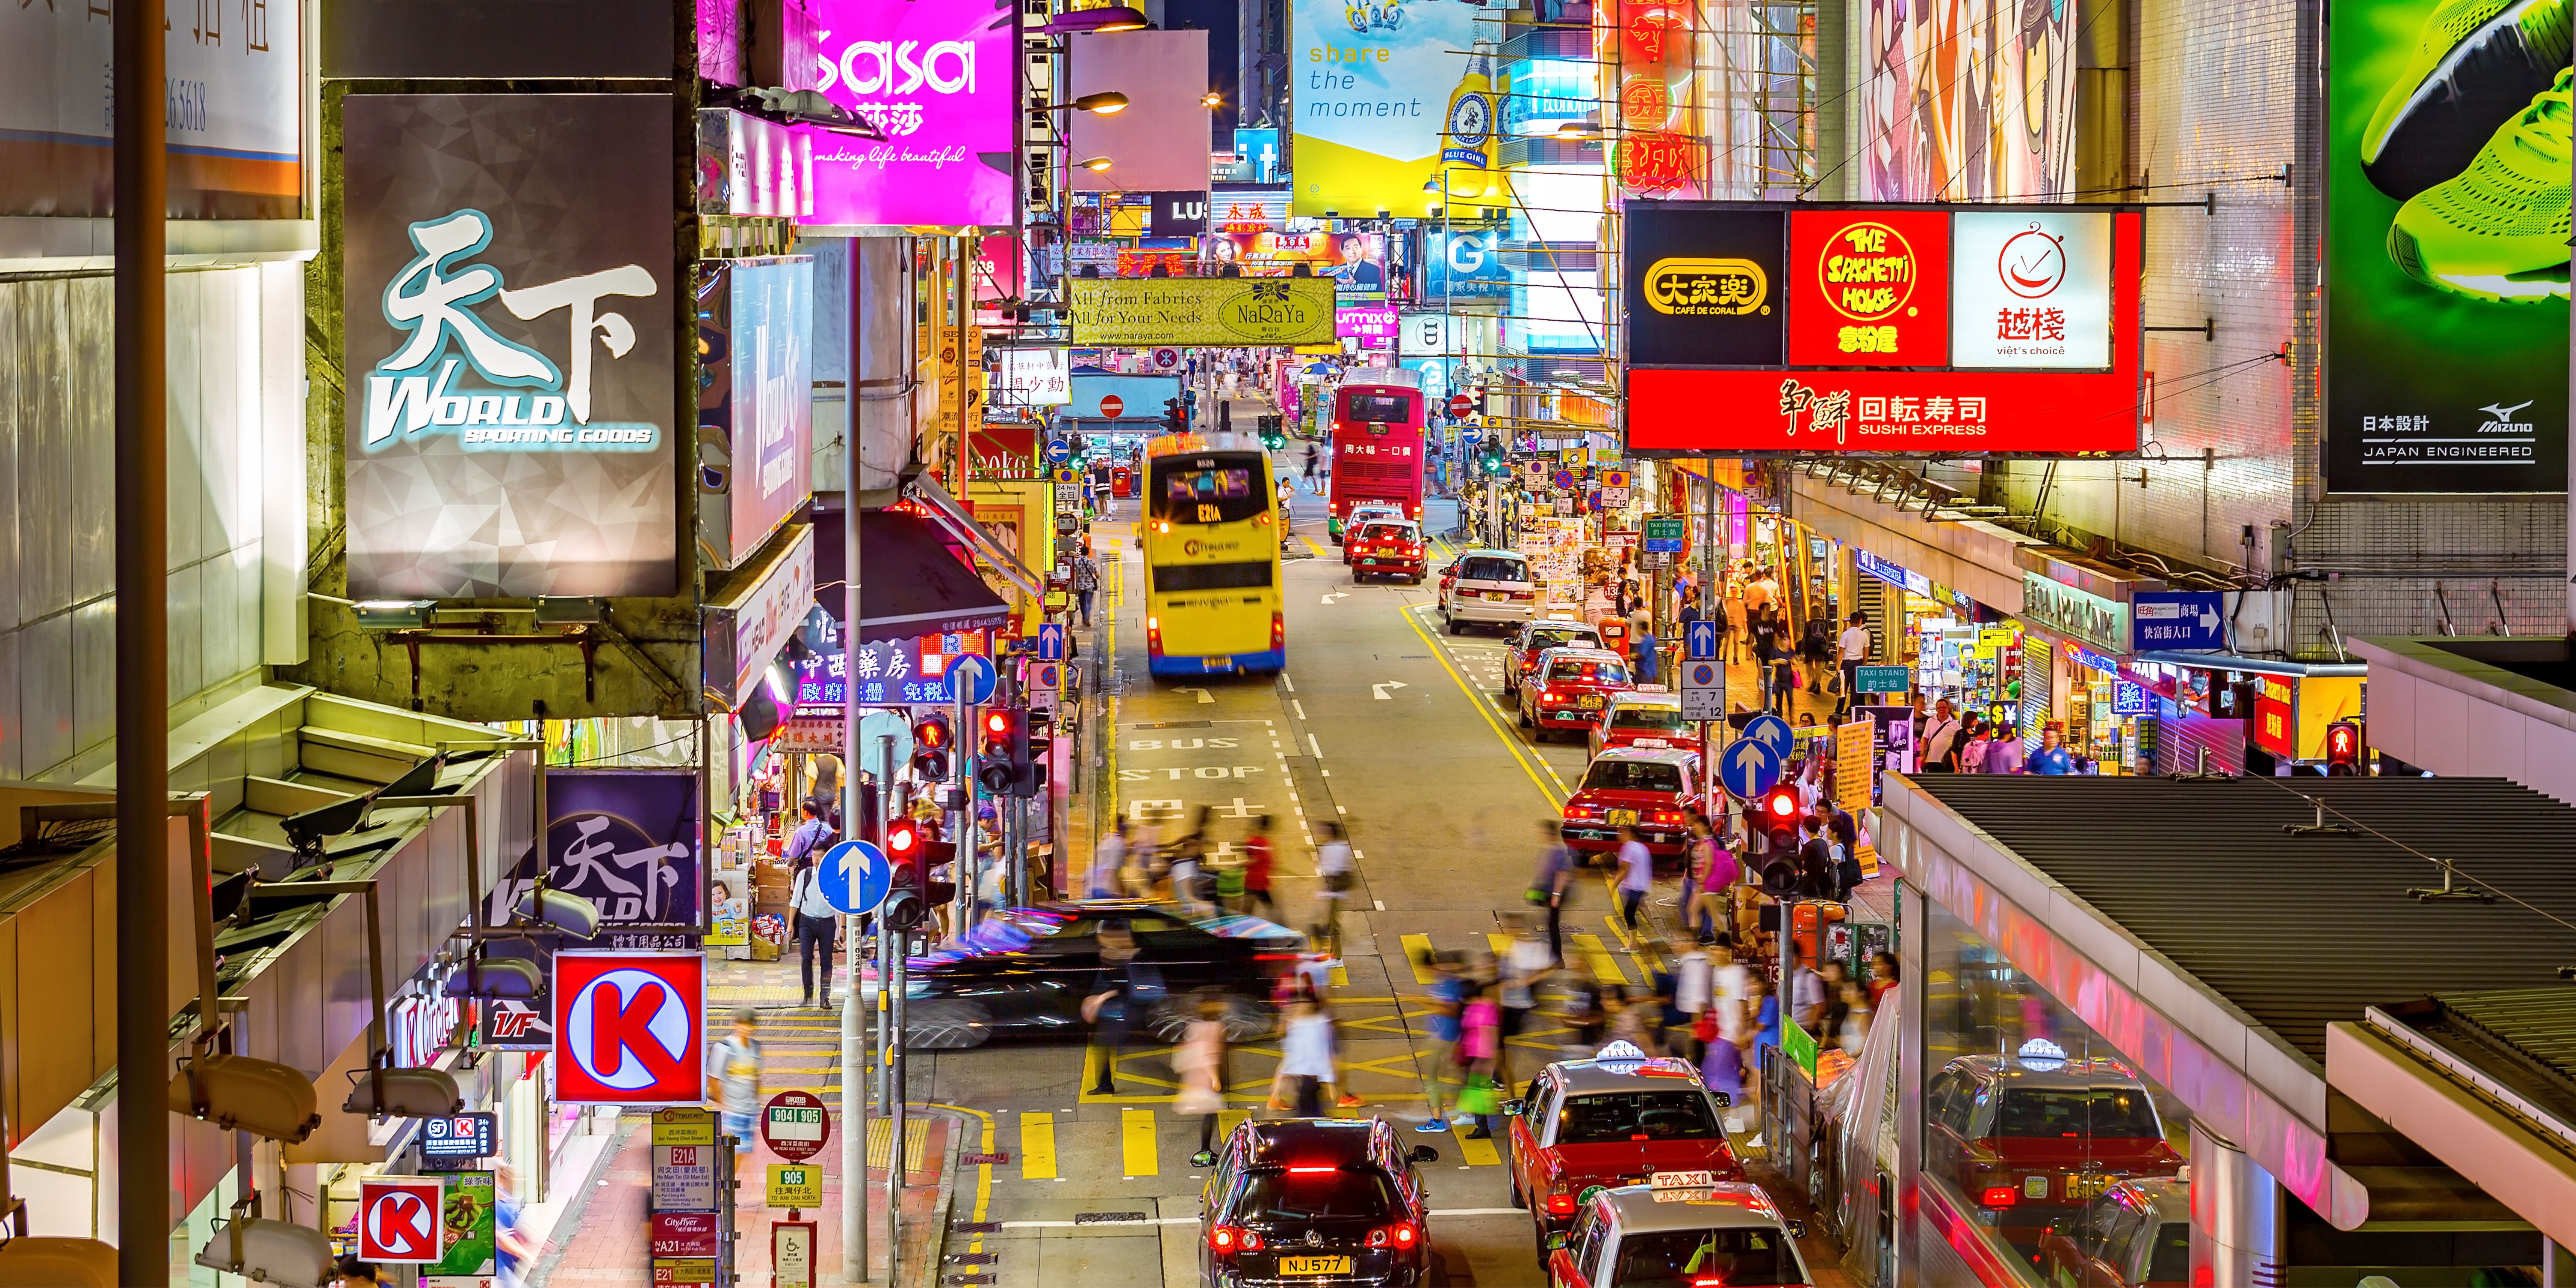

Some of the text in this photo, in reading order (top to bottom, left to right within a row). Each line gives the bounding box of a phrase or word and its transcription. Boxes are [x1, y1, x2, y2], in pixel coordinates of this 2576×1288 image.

[1310, 43, 1389, 62] share
[1311, 71, 1354, 89] the
[1310, 98, 1420, 116] moment
[814, 146, 965, 170] making life beautiful
[1467, 154, 1484, 164] GIRL
[1228, 203, 1265, 220] 永成
[1845, 228, 1887, 253] THE
[1072, 290, 1201, 306] All from Fabrics
[1842, 287, 1897, 314] HOUSE
[382, 210, 658, 425] 天下
[1238, 305, 1304, 324] NaRaYa
[1675, 305, 1695, 314] CAFÉ
[1074, 310, 1201, 326] All for Your Needs
[1997, 307, 2064, 341] 越棧
[1100, 333, 1173, 342] www.naraya.com
[1838, 326, 1898, 353] 意粉屋
[368, 360, 563, 444] WORLD
[1859, 425, 1986, 435] SUSHI EXPRESS
[2364, 415, 2429, 431] 日本設計
[465, 428, 652, 444] SPORTING GOODS
[1345, 445, 1410, 456] 周大福 一口價
[2364, 447, 2531, 456] JAPAN ENGINEERED
[1198, 504, 1221, 522] E21A
[2138, 606, 2154, 616] 旺角
[2181, 604, 2198, 617] 商場
[2145, 626, 2190, 639] 快富街入口
[1709, 692, 1715, 701] 7
[1710, 707, 1721, 716] 12
[2266, 713, 2281, 739] 意粉屋
[1129, 738, 1238, 750] BUS
[1117, 766, 1265, 782] STOP
[561, 815, 689, 921] 天下
[592, 980, 680, 1083] K
[776, 1110, 819, 1123] 904 905
[671, 1147, 696, 1165] E21A
[463, 1176, 493, 1187] 綠茶味
[785, 1172, 801, 1184] 905
[1657, 1174, 1708, 1186] TAXI
[380, 1197, 429, 1252] K
[660, 1241, 678, 1251] A21
[1289, 1259, 1341, 1271] NJ 577
[656, 1269, 671, 1280] E21
